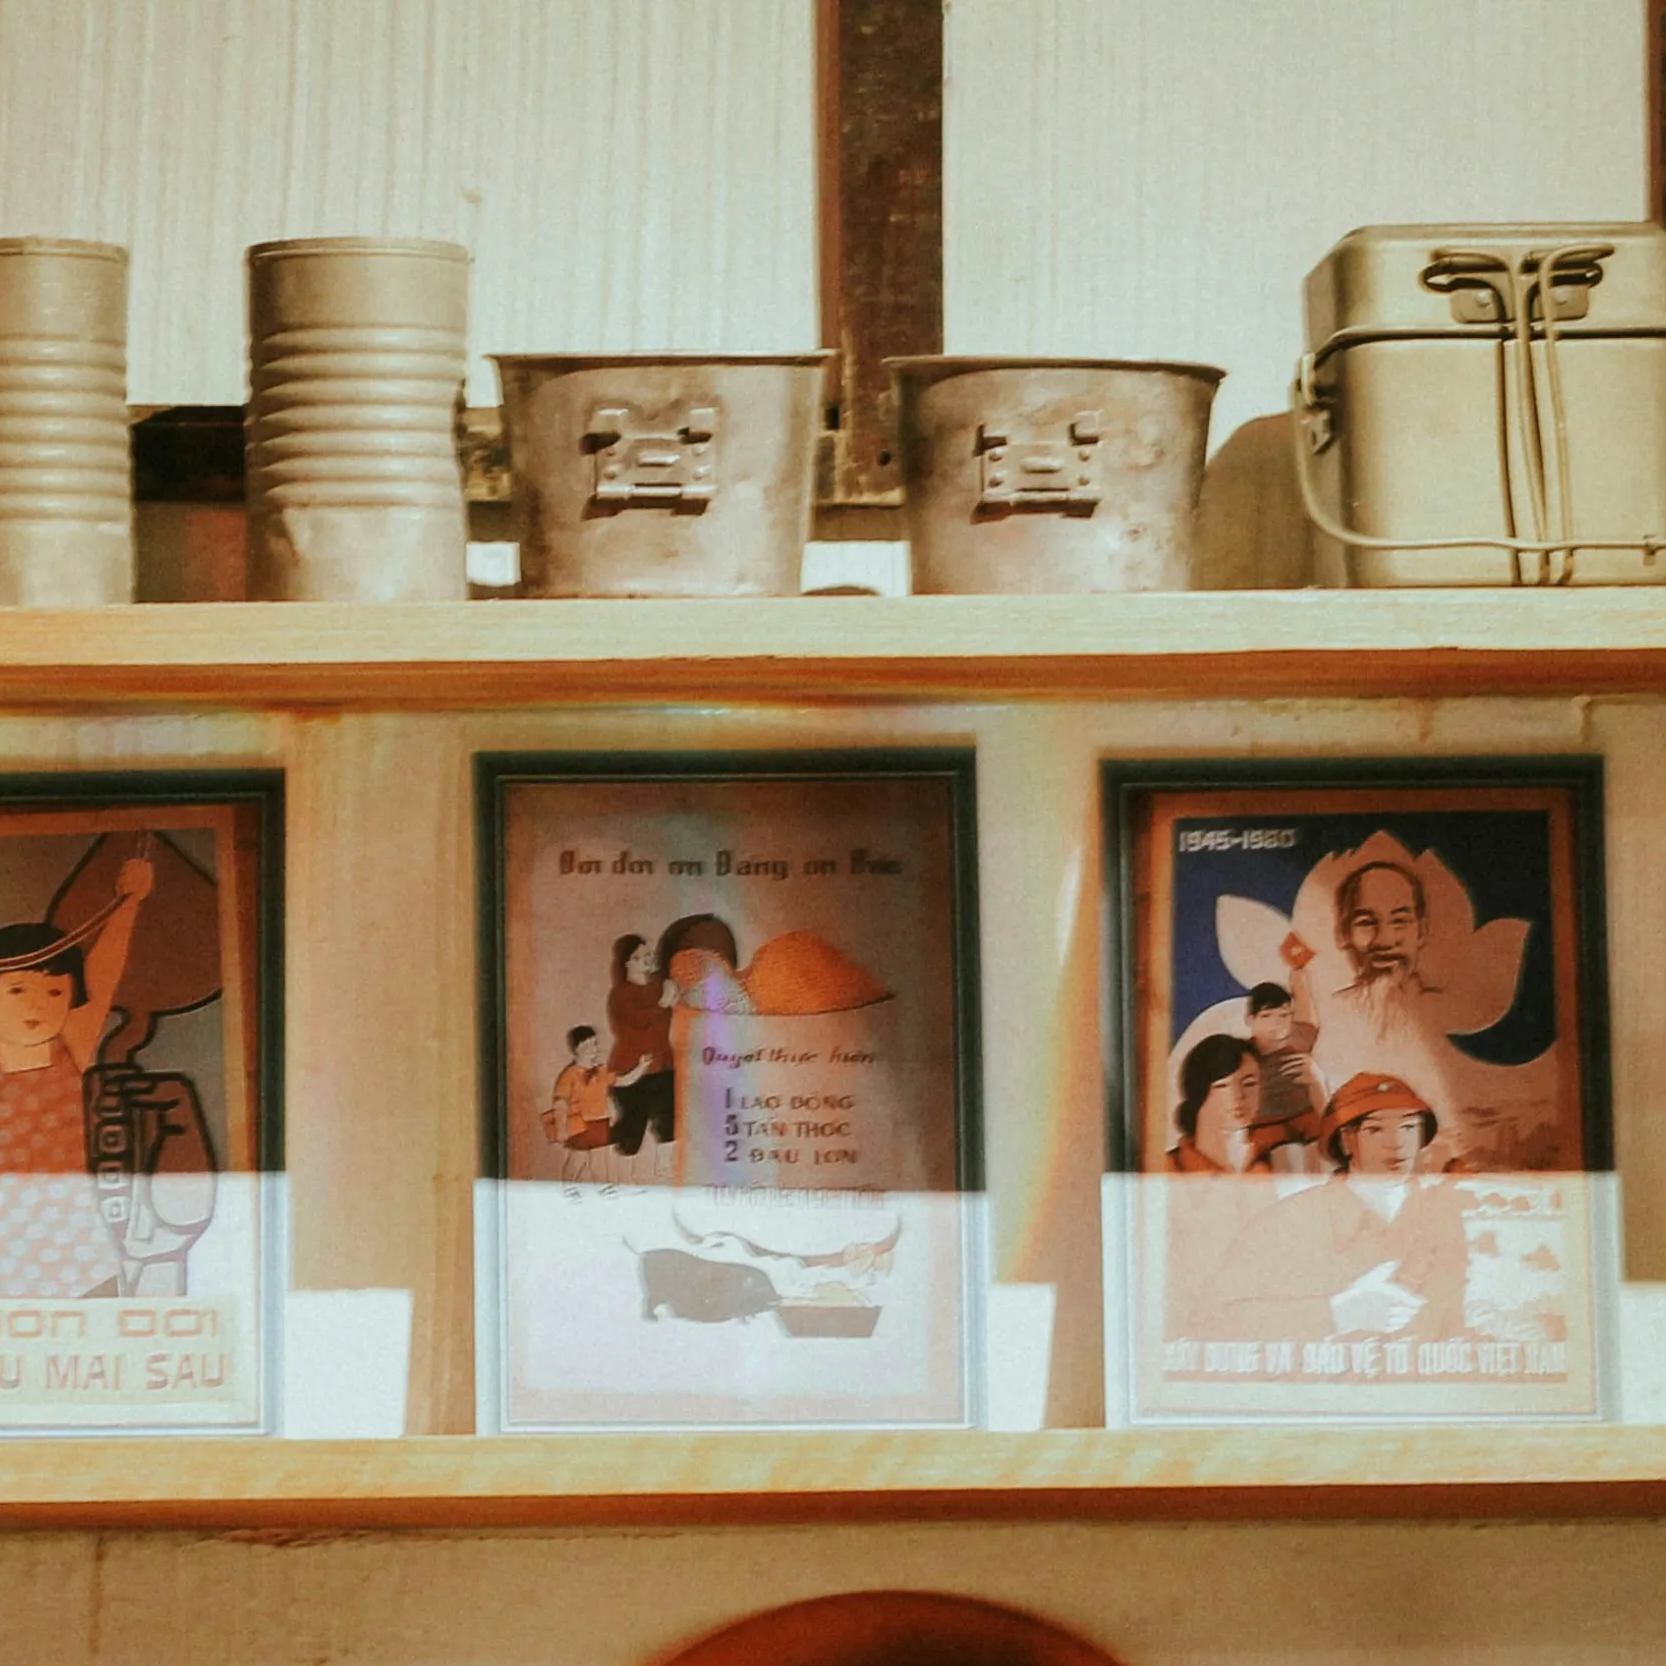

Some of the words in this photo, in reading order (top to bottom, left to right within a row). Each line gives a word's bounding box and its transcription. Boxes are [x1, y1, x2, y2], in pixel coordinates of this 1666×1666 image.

[724, 1140, 740, 1163] 2
[46, 1353, 123, 1390] MAI
[145, 1352, 227, 1390] SAU
